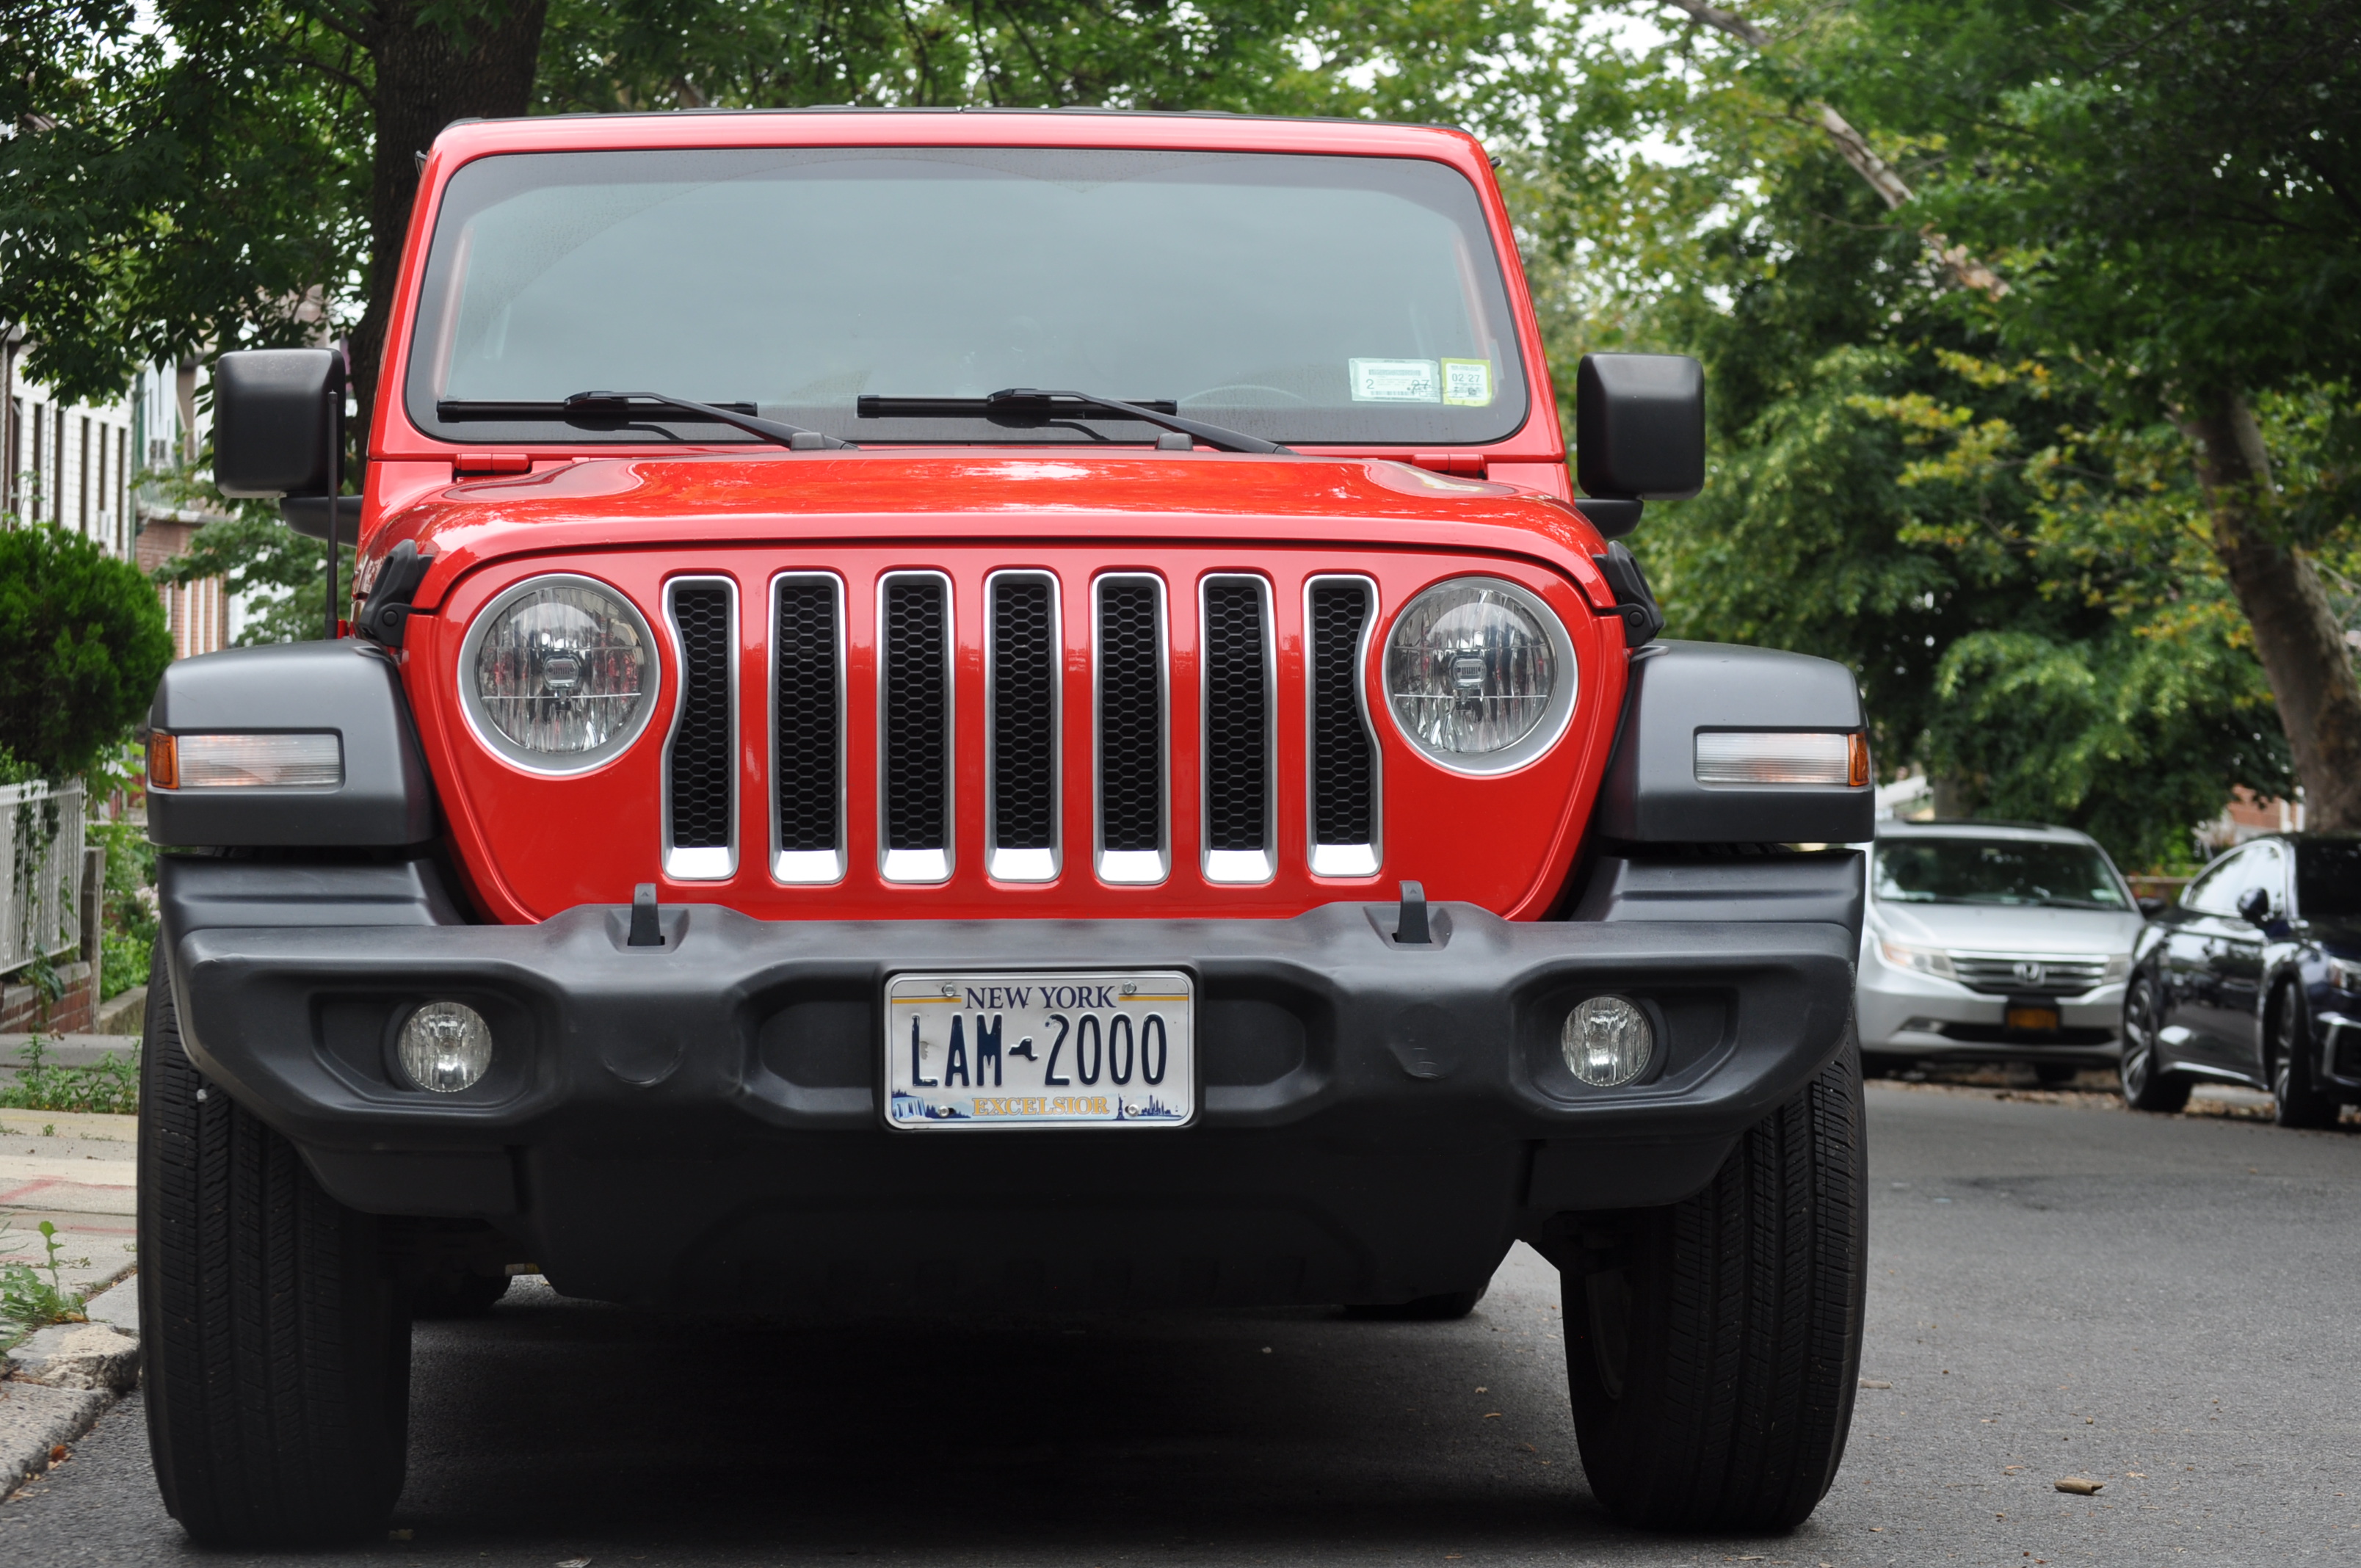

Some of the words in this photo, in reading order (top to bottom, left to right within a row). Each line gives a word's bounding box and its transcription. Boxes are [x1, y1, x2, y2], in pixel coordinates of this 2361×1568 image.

[1366, 378, 1374, 389] 2
[1452, 373, 1464, 382] 02
[1468, 374, 1480, 382] 27
[965, 986, 1031, 1009] NEW
[1039, 985, 1117, 1009] YORK
[911, 1013, 1003, 1087] LAM
[1044, 1013, 1167, 1086] 2000
[972, 1096, 1110, 1117] EXCELSIOR
